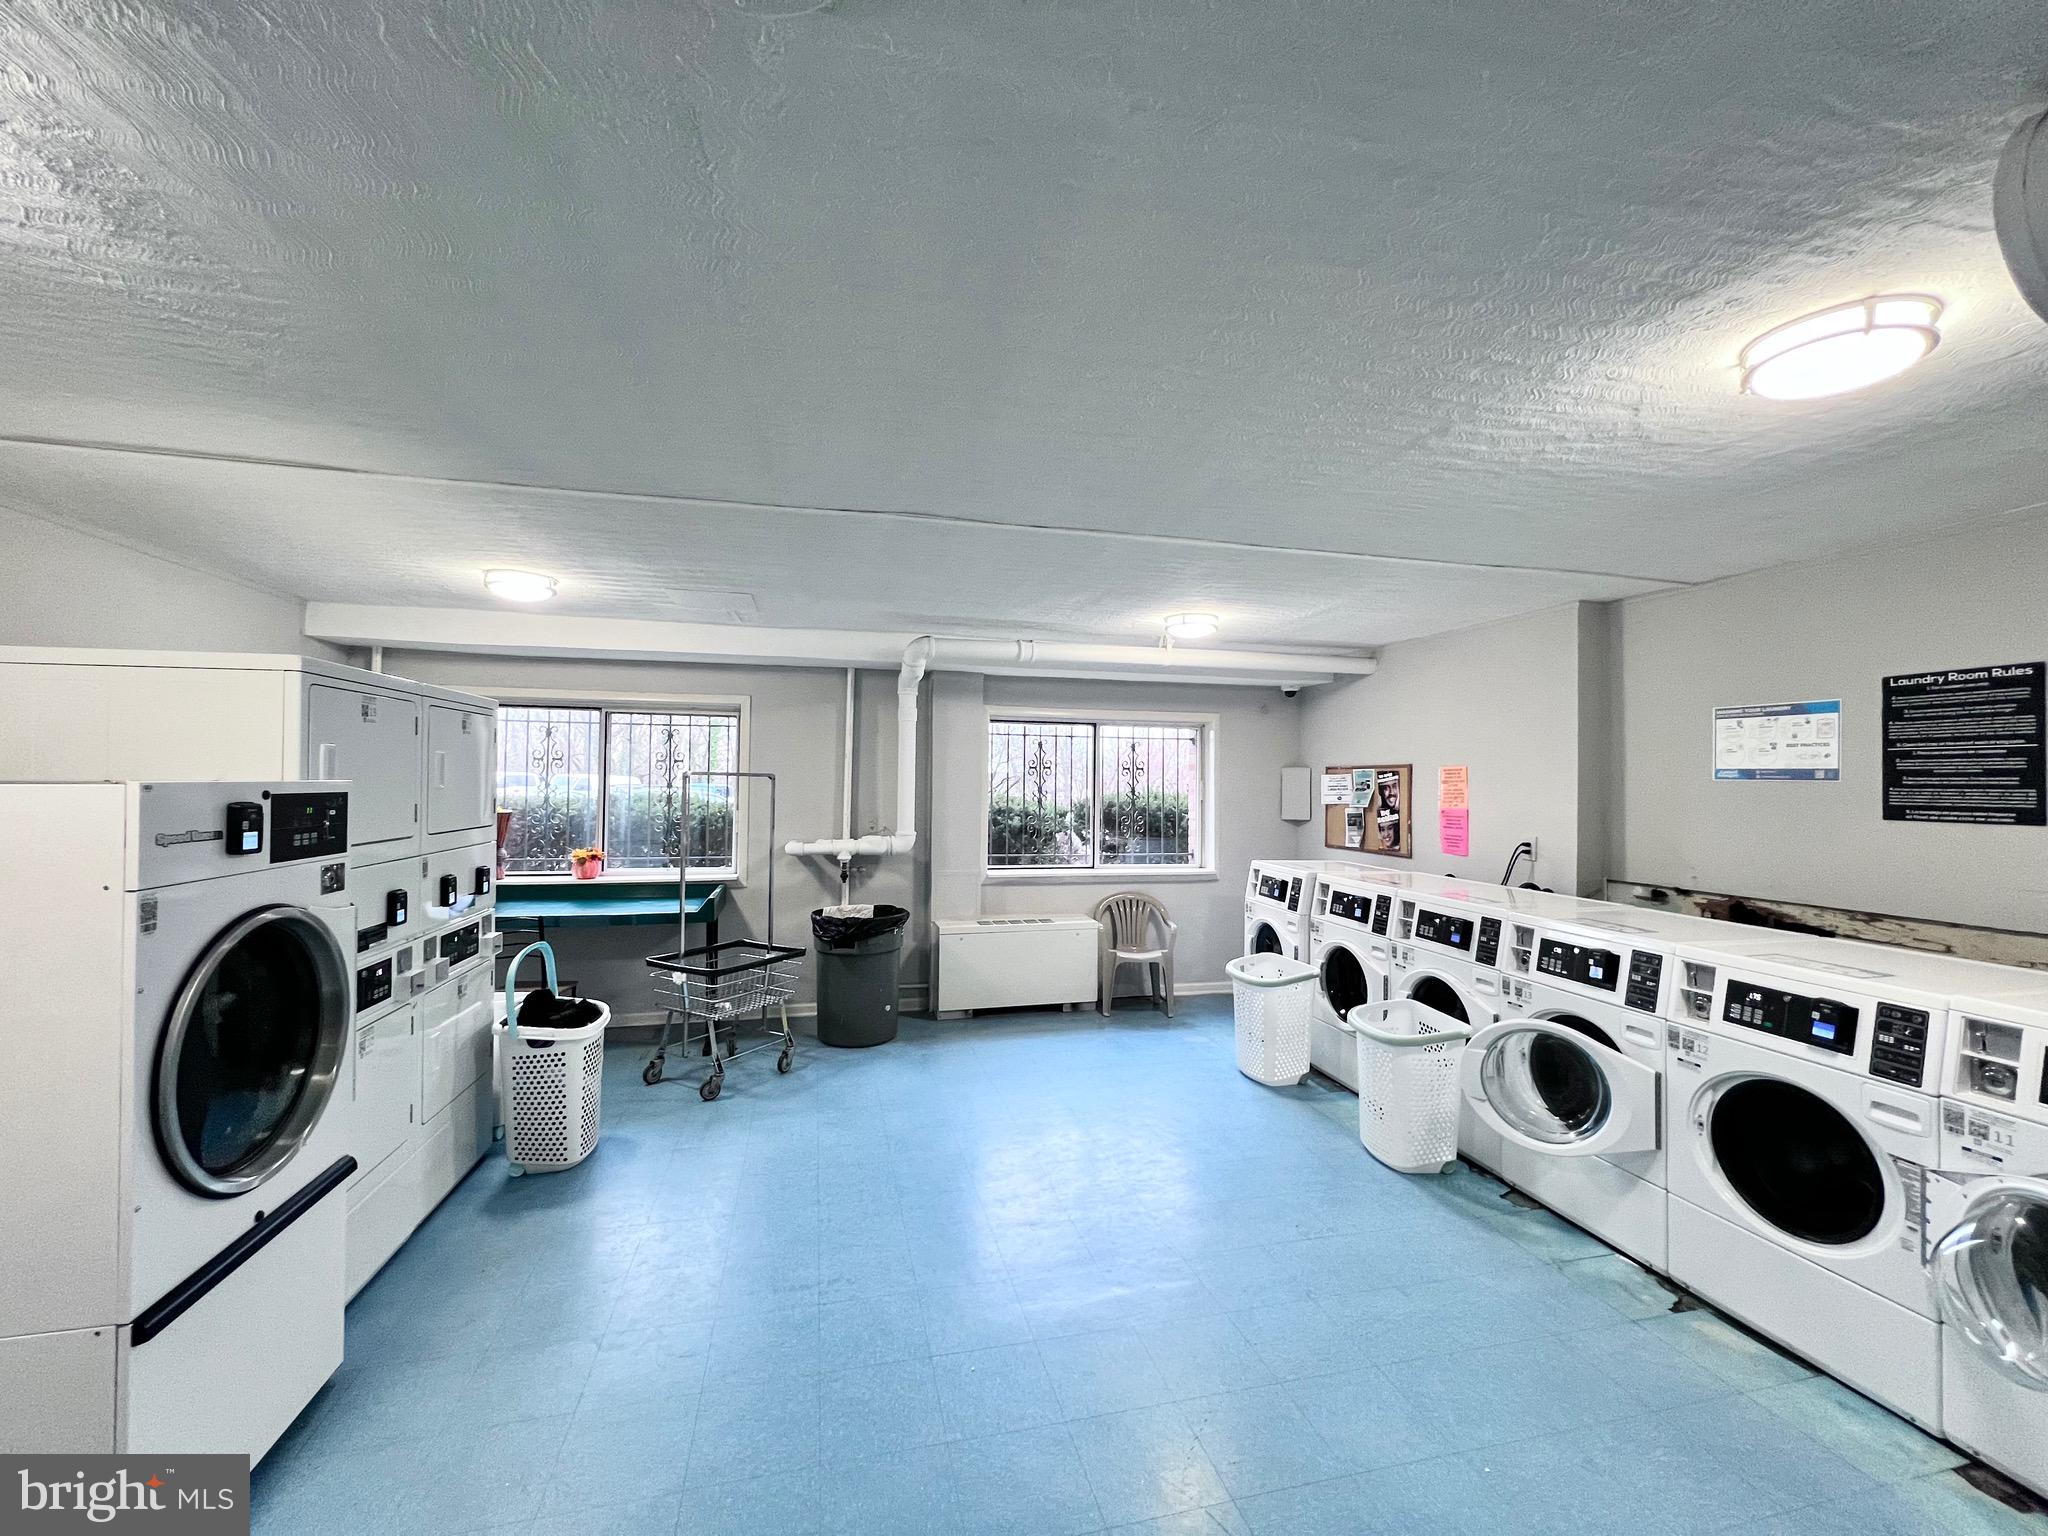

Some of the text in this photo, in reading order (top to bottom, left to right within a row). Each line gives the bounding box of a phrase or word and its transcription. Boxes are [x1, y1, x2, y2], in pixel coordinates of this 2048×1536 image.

[1890, 675, 1945, 687] Laundry
[1948, 671, 1988, 681] Room
[1991, 667, 2034, 678] Rules
